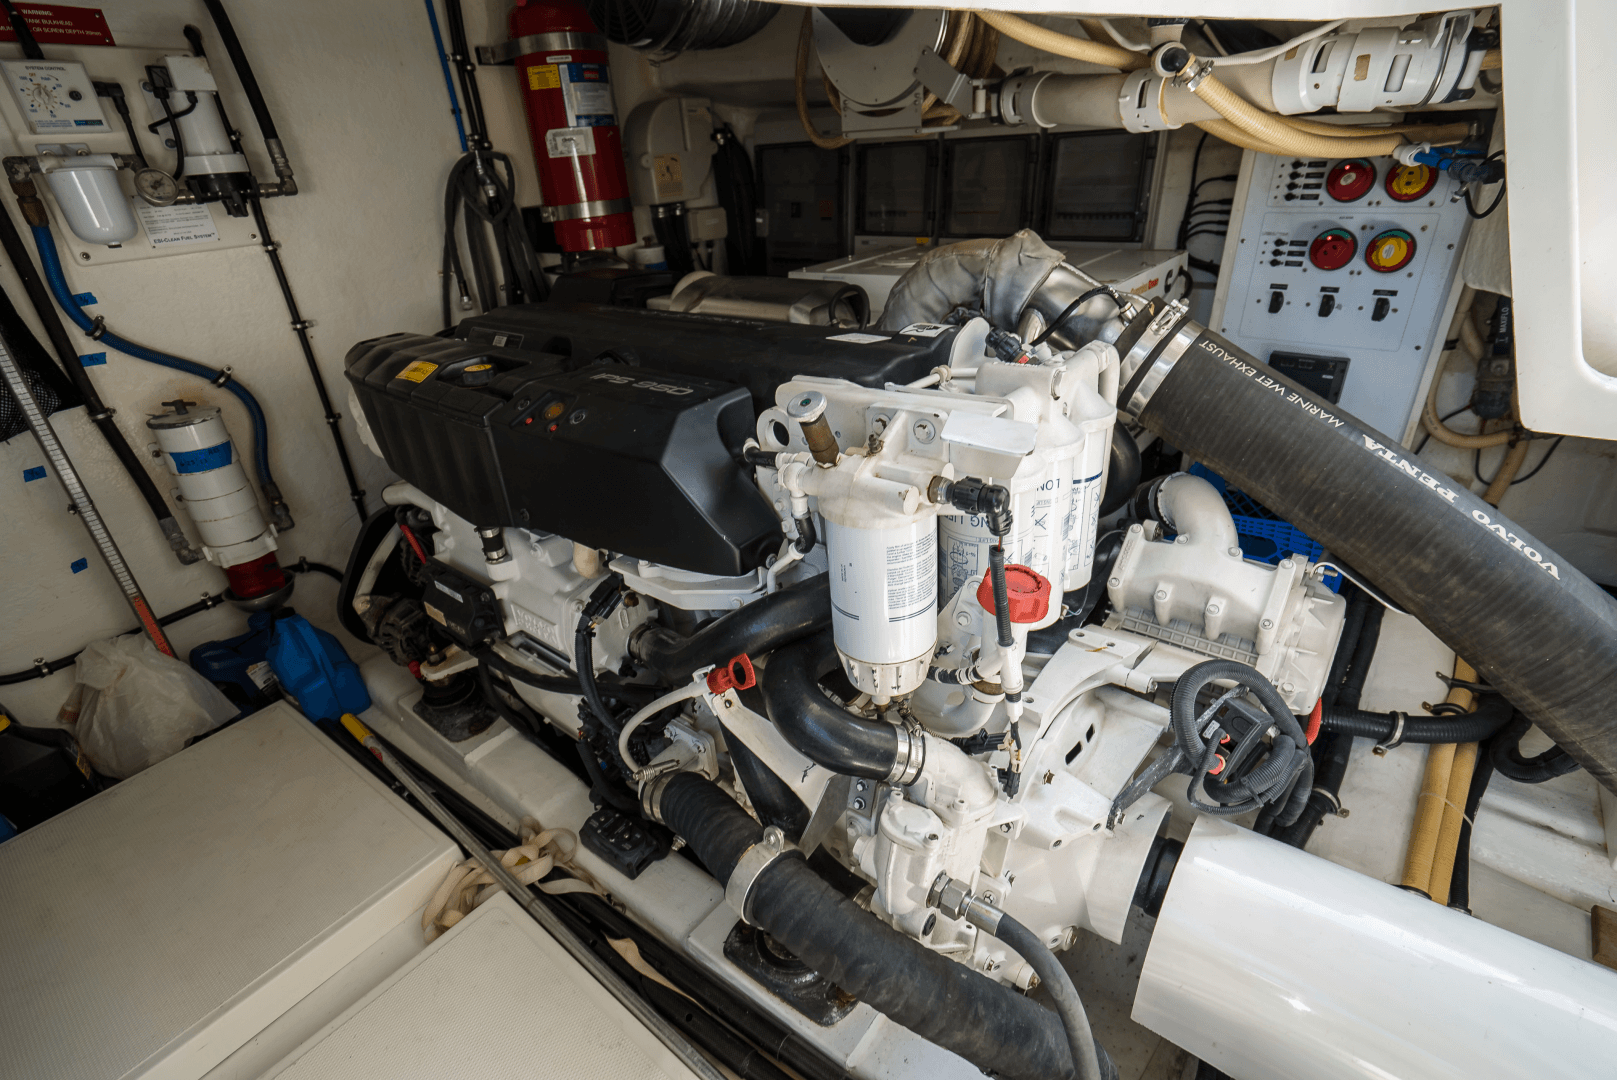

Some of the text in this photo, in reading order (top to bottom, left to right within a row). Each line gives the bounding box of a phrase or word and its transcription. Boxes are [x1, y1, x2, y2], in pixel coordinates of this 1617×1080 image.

[1499, 307, 1509, 333] MAXIFLO
[590, 373, 694, 395] IPS 950
[1199, 339, 1561, 581] VOLVO PENTA MARINE WET EXHAUST
